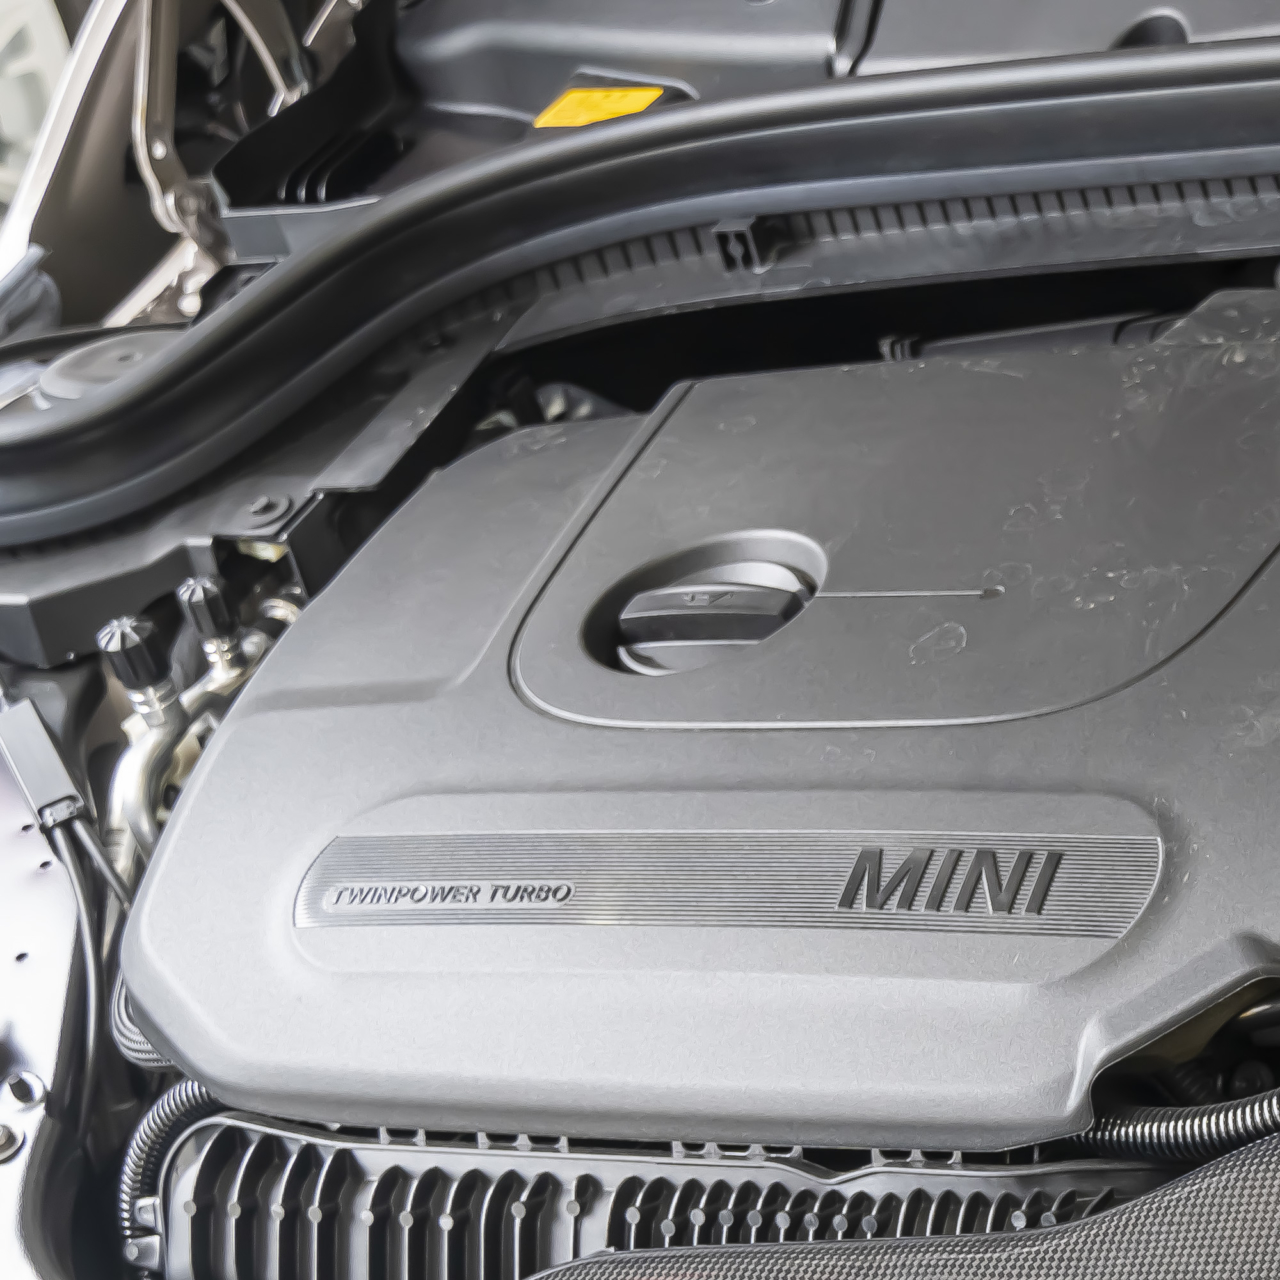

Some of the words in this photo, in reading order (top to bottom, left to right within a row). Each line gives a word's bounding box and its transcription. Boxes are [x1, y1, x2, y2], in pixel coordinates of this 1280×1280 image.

[333, 884, 482, 905] TWINPOWER
[489, 883, 573, 904] TURBO
[836, 848, 1062, 915] MINI
